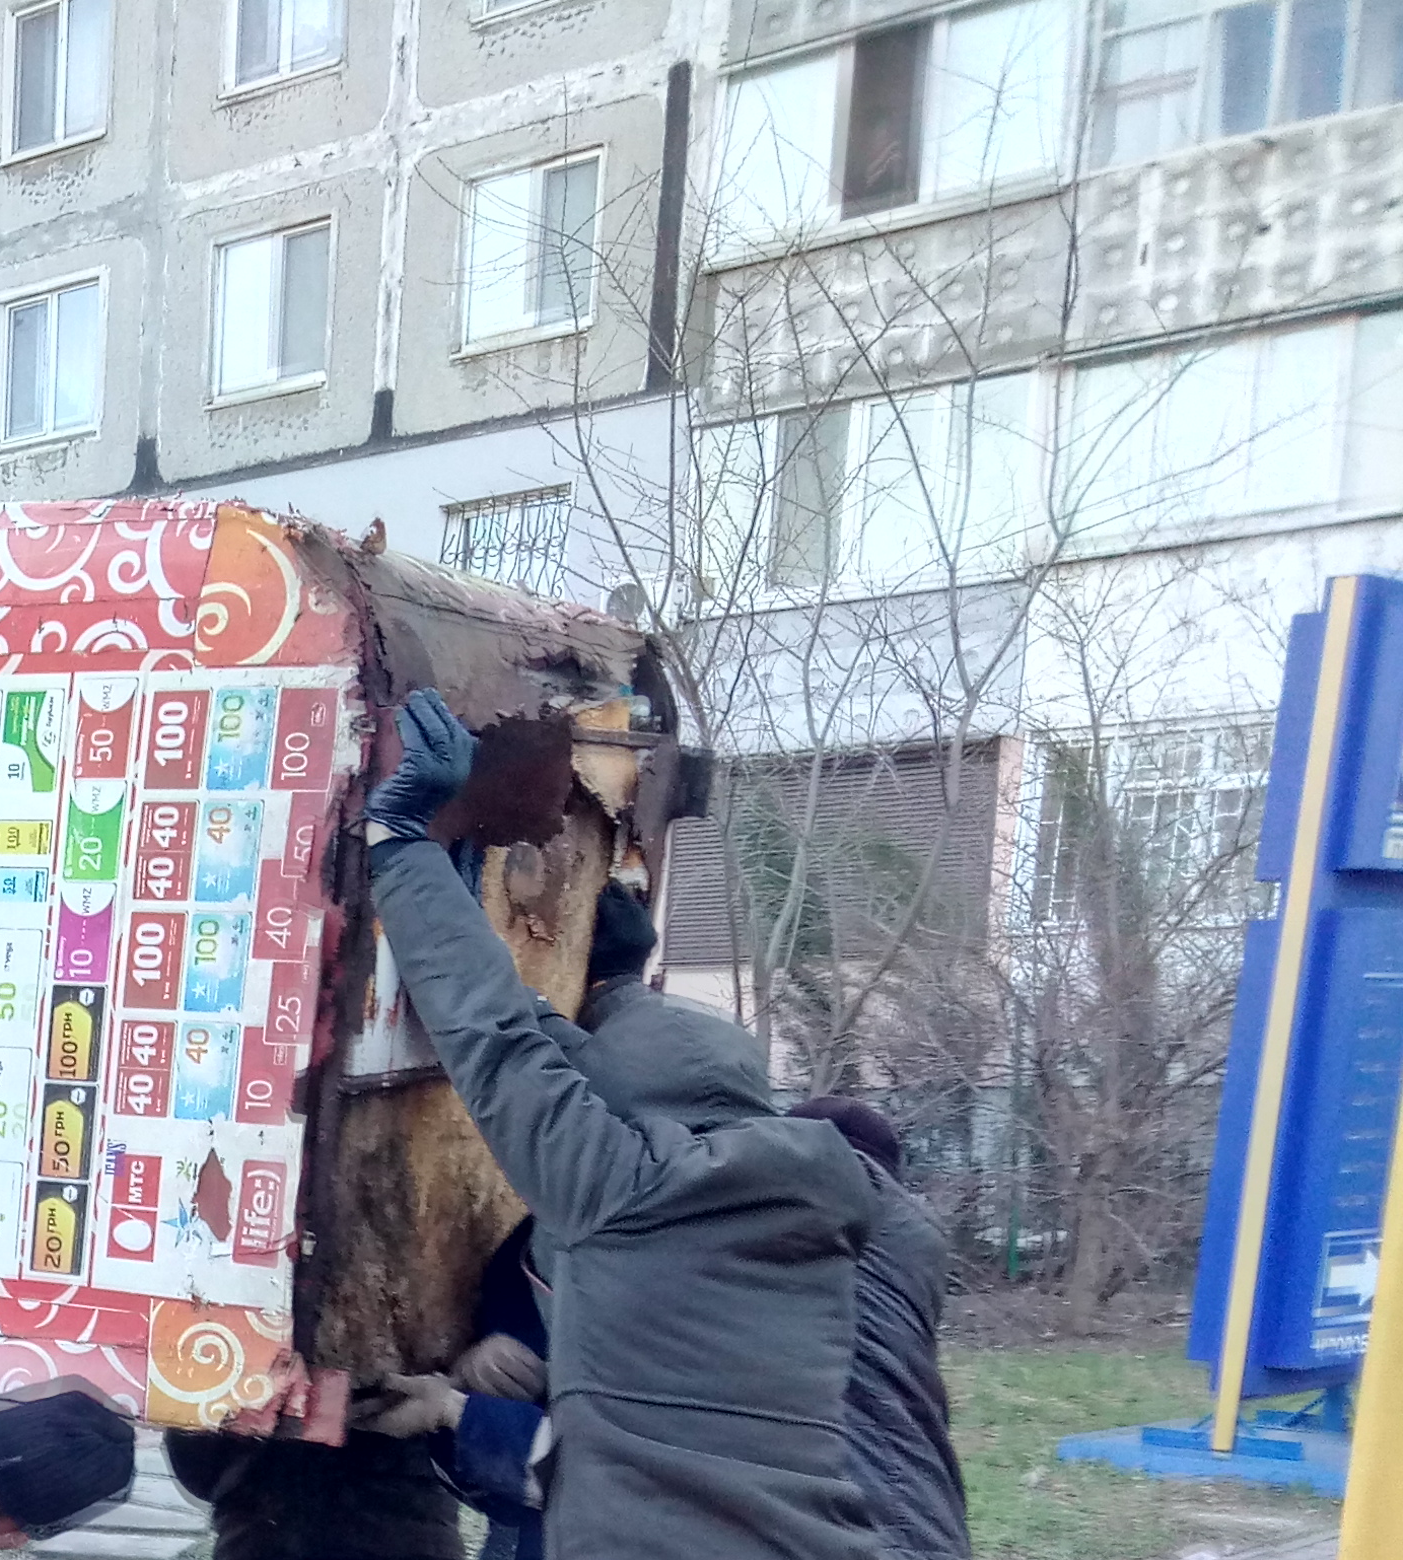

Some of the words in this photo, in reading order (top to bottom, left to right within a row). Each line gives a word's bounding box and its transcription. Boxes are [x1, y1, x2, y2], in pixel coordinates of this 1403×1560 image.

[100, 683, 113, 711] WMZ
[153, 701, 189, 767] 100
[215, 695, 245, 743] 100
[90, 728, 115, 763] 50
[280, 731, 310, 781] 100
[7, 763, 21, 779] 10
[90, 785, 102, 812] WMZ
[5, 826, 19, 850] 100
[152, 806, 180, 849] 40
[205, 806, 232, 845] 40
[294, 824, 314, 863] 50
[78, 836, 103, 871] 20
[147, 855, 175, 899] 40
[68, 949, 94, 978] 10
[81, 886, 93, 915] WMZ
[193, 919, 221, 966] 100
[264, 906, 292, 949] 40
[131, 921, 166, 987] 100
[275, 994, 301, 1033] 25
[58, 1041, 78, 1077] 100
[134, 1024, 159, 1066] 40
[184, 1028, 210, 1065] 40
[129, 1073, 155, 1115] 40
[243, 1079, 273, 1110] 10
[51, 1140, 71, 1173] 50
[127, 1160, 145, 1204] МТС
[44, 1235, 63, 1270] 20
